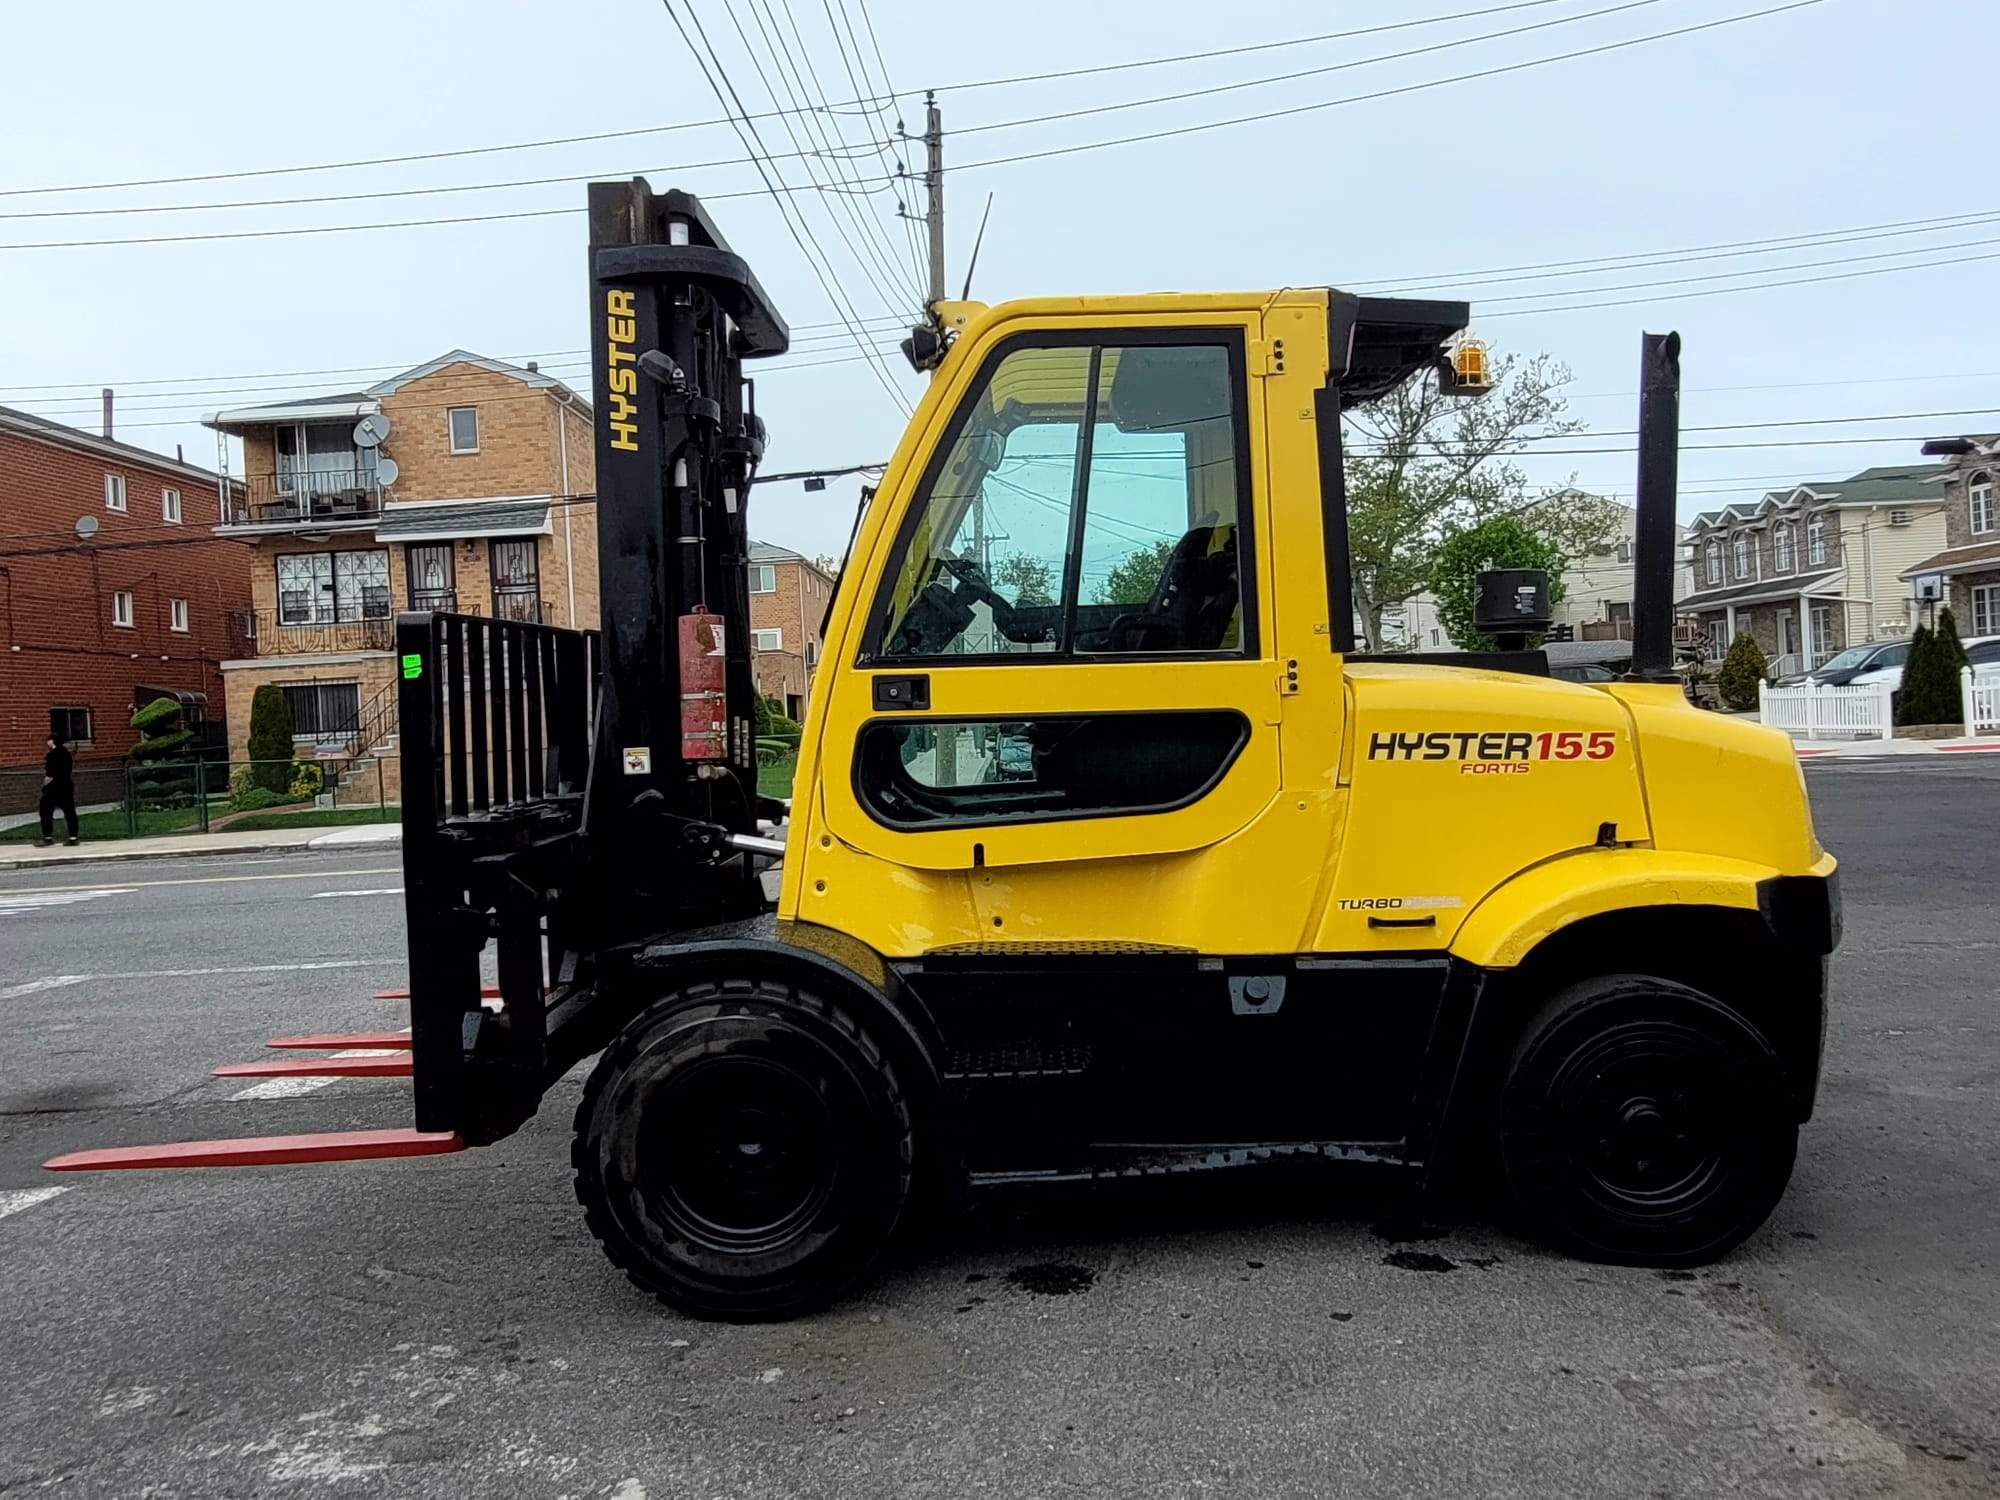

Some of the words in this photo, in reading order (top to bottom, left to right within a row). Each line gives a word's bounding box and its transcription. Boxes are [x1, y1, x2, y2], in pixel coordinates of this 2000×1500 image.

[607, 289, 639, 451] HYSTER
[1367, 732, 1532, 760] HYSTER
[1536, 732, 1616, 760] 155
[1460, 763, 1530, 774] FORTIS
[1338, 898, 1403, 910] TURBO
